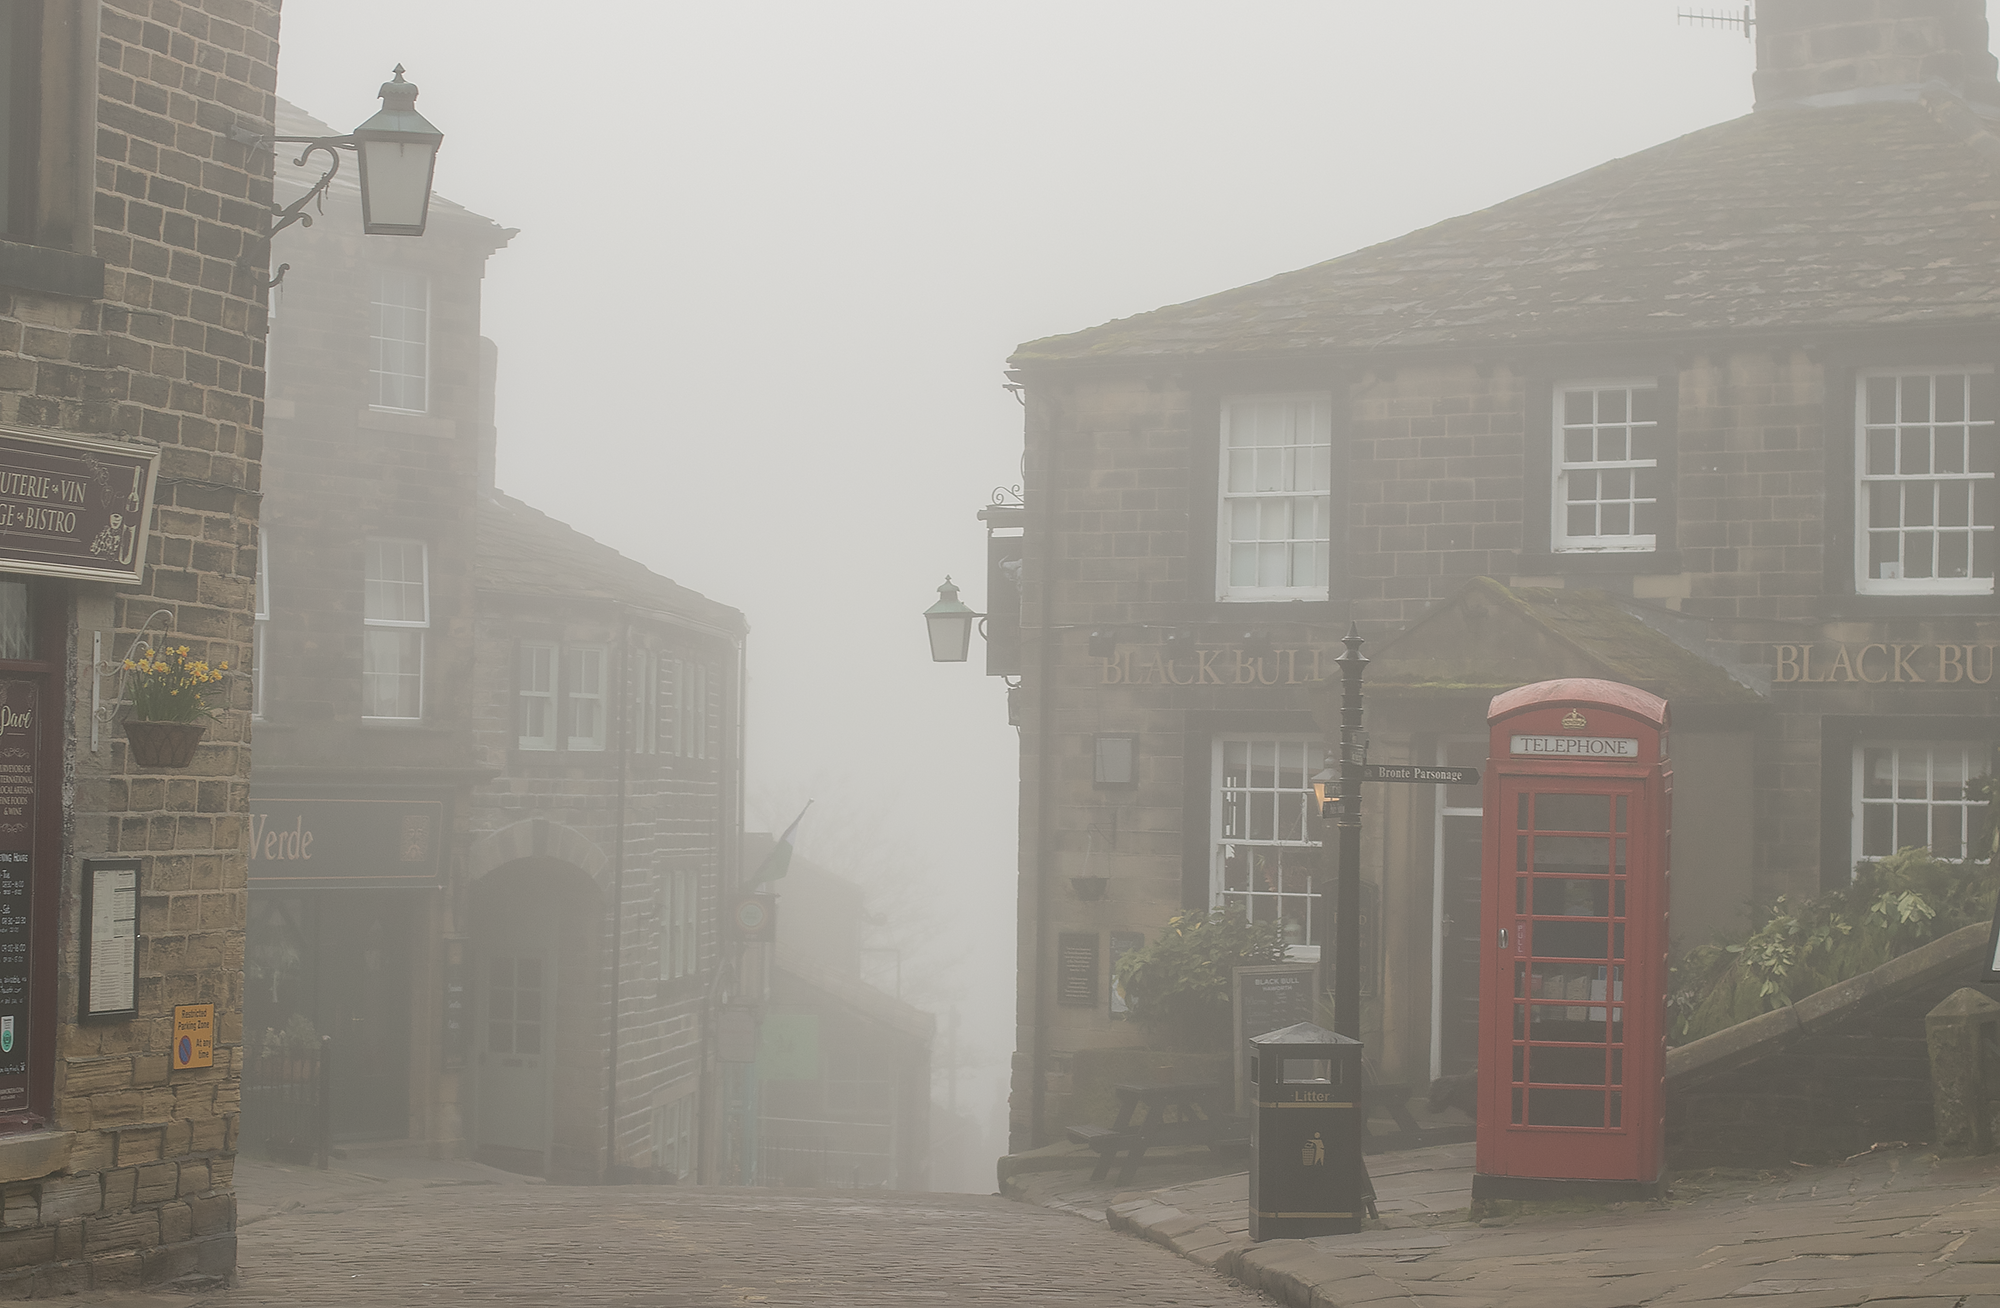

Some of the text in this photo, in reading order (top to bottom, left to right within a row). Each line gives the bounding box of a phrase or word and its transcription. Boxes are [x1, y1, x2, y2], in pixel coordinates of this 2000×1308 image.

[0, 471, 87, 503] UTERIE VIN
[25, 507, 76, 533] BISTRO
[1099, 649, 1226, 685] BLACK
[1772, 644, 2000, 684] BLACK BU
[1520, 737, 1628, 755] TELEPHONE
[1379, 766, 1463, 782] Bronte Parsonage
[248, 814, 314, 860] Verde
[1255, 977, 1299, 986] BLACK BULL
[181, 1009, 207, 1018] Restricted
[178, 1020, 210, 1031] Parking Zone
[1295, 1090, 1331, 1102] Litter
